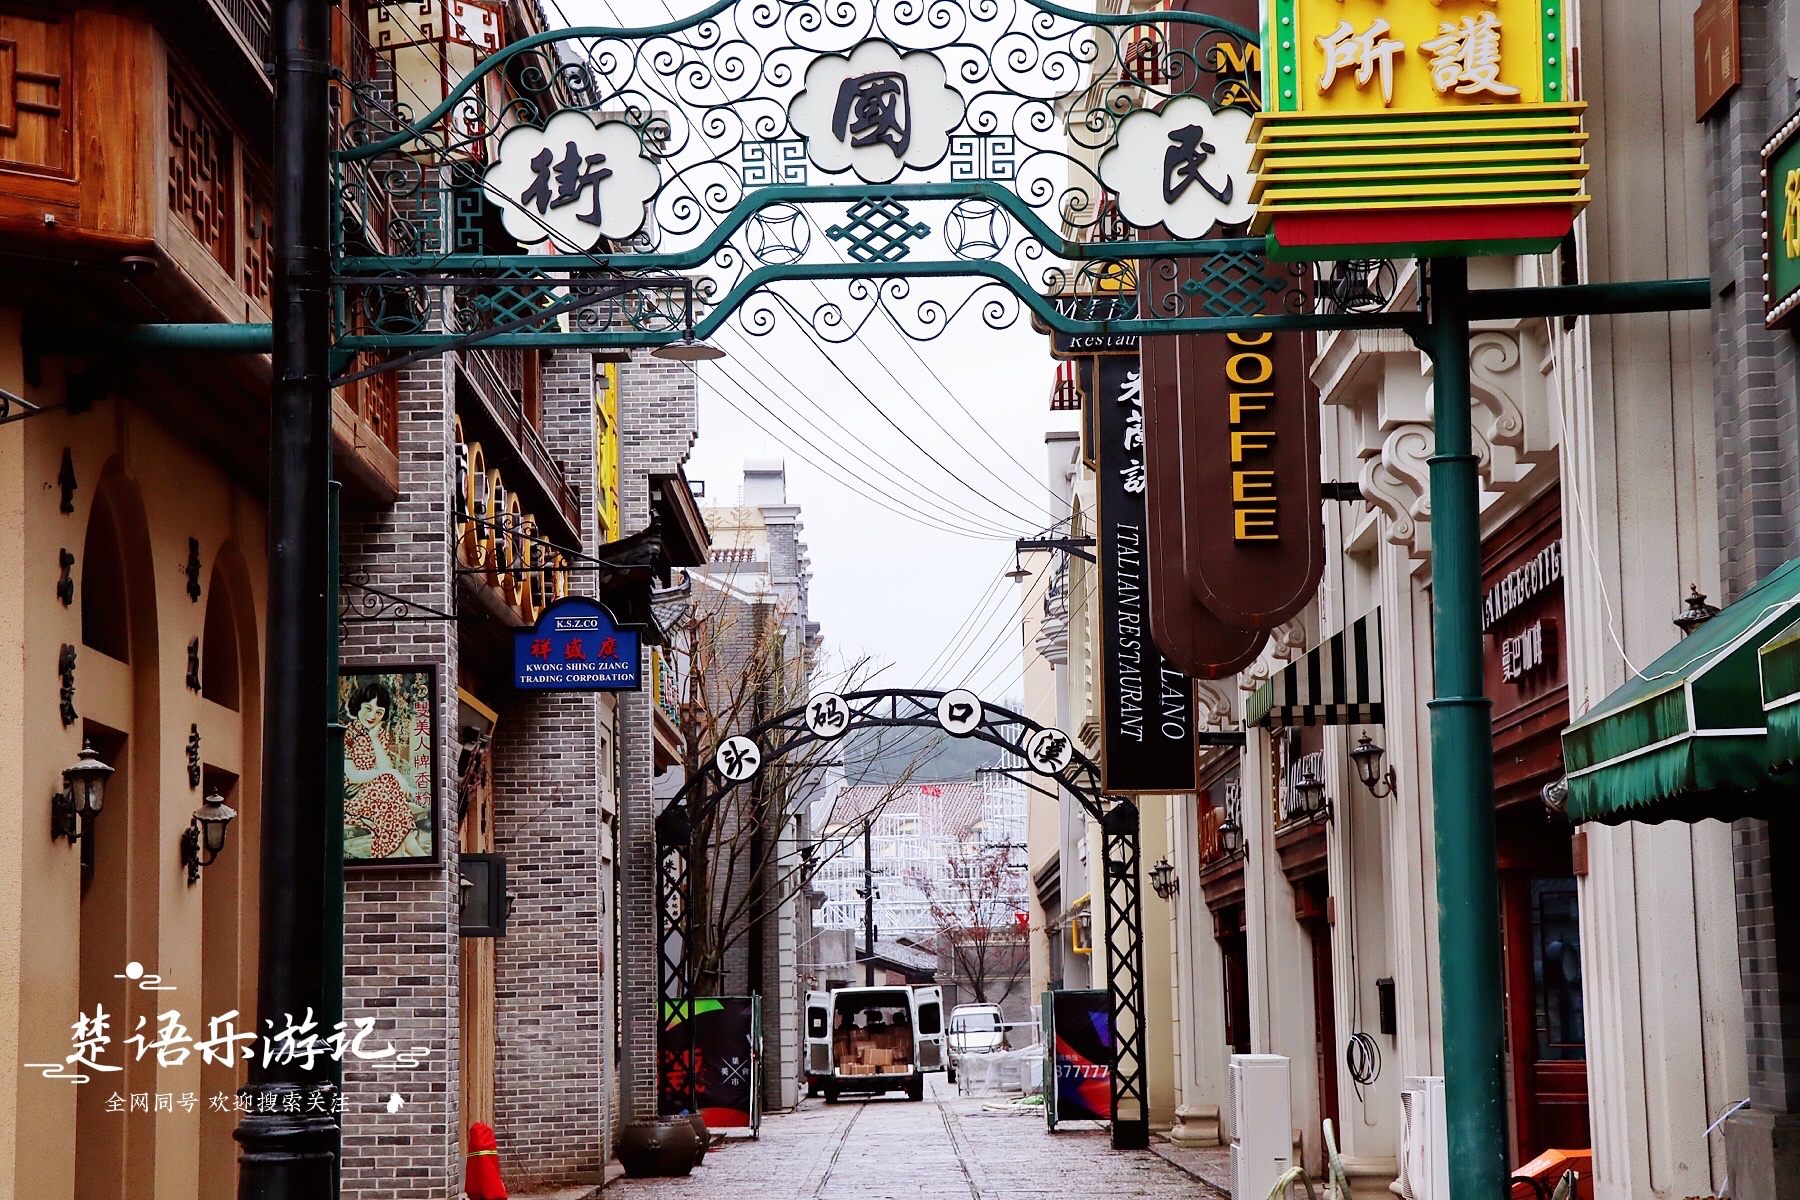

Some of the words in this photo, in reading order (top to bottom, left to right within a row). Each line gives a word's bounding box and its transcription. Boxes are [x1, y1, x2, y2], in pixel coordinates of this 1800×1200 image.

[1116, 522, 1141, 608] ITALIAN
[520, 675, 563, 683] TRADING
[526, 663, 563, 672] KWONG
[566, 662, 596, 671] SHING
[598, 661, 629, 670] ZIANG
[1117, 610, 1143, 742] RESTAURANT
[1159, 655, 1186, 740] LANO
